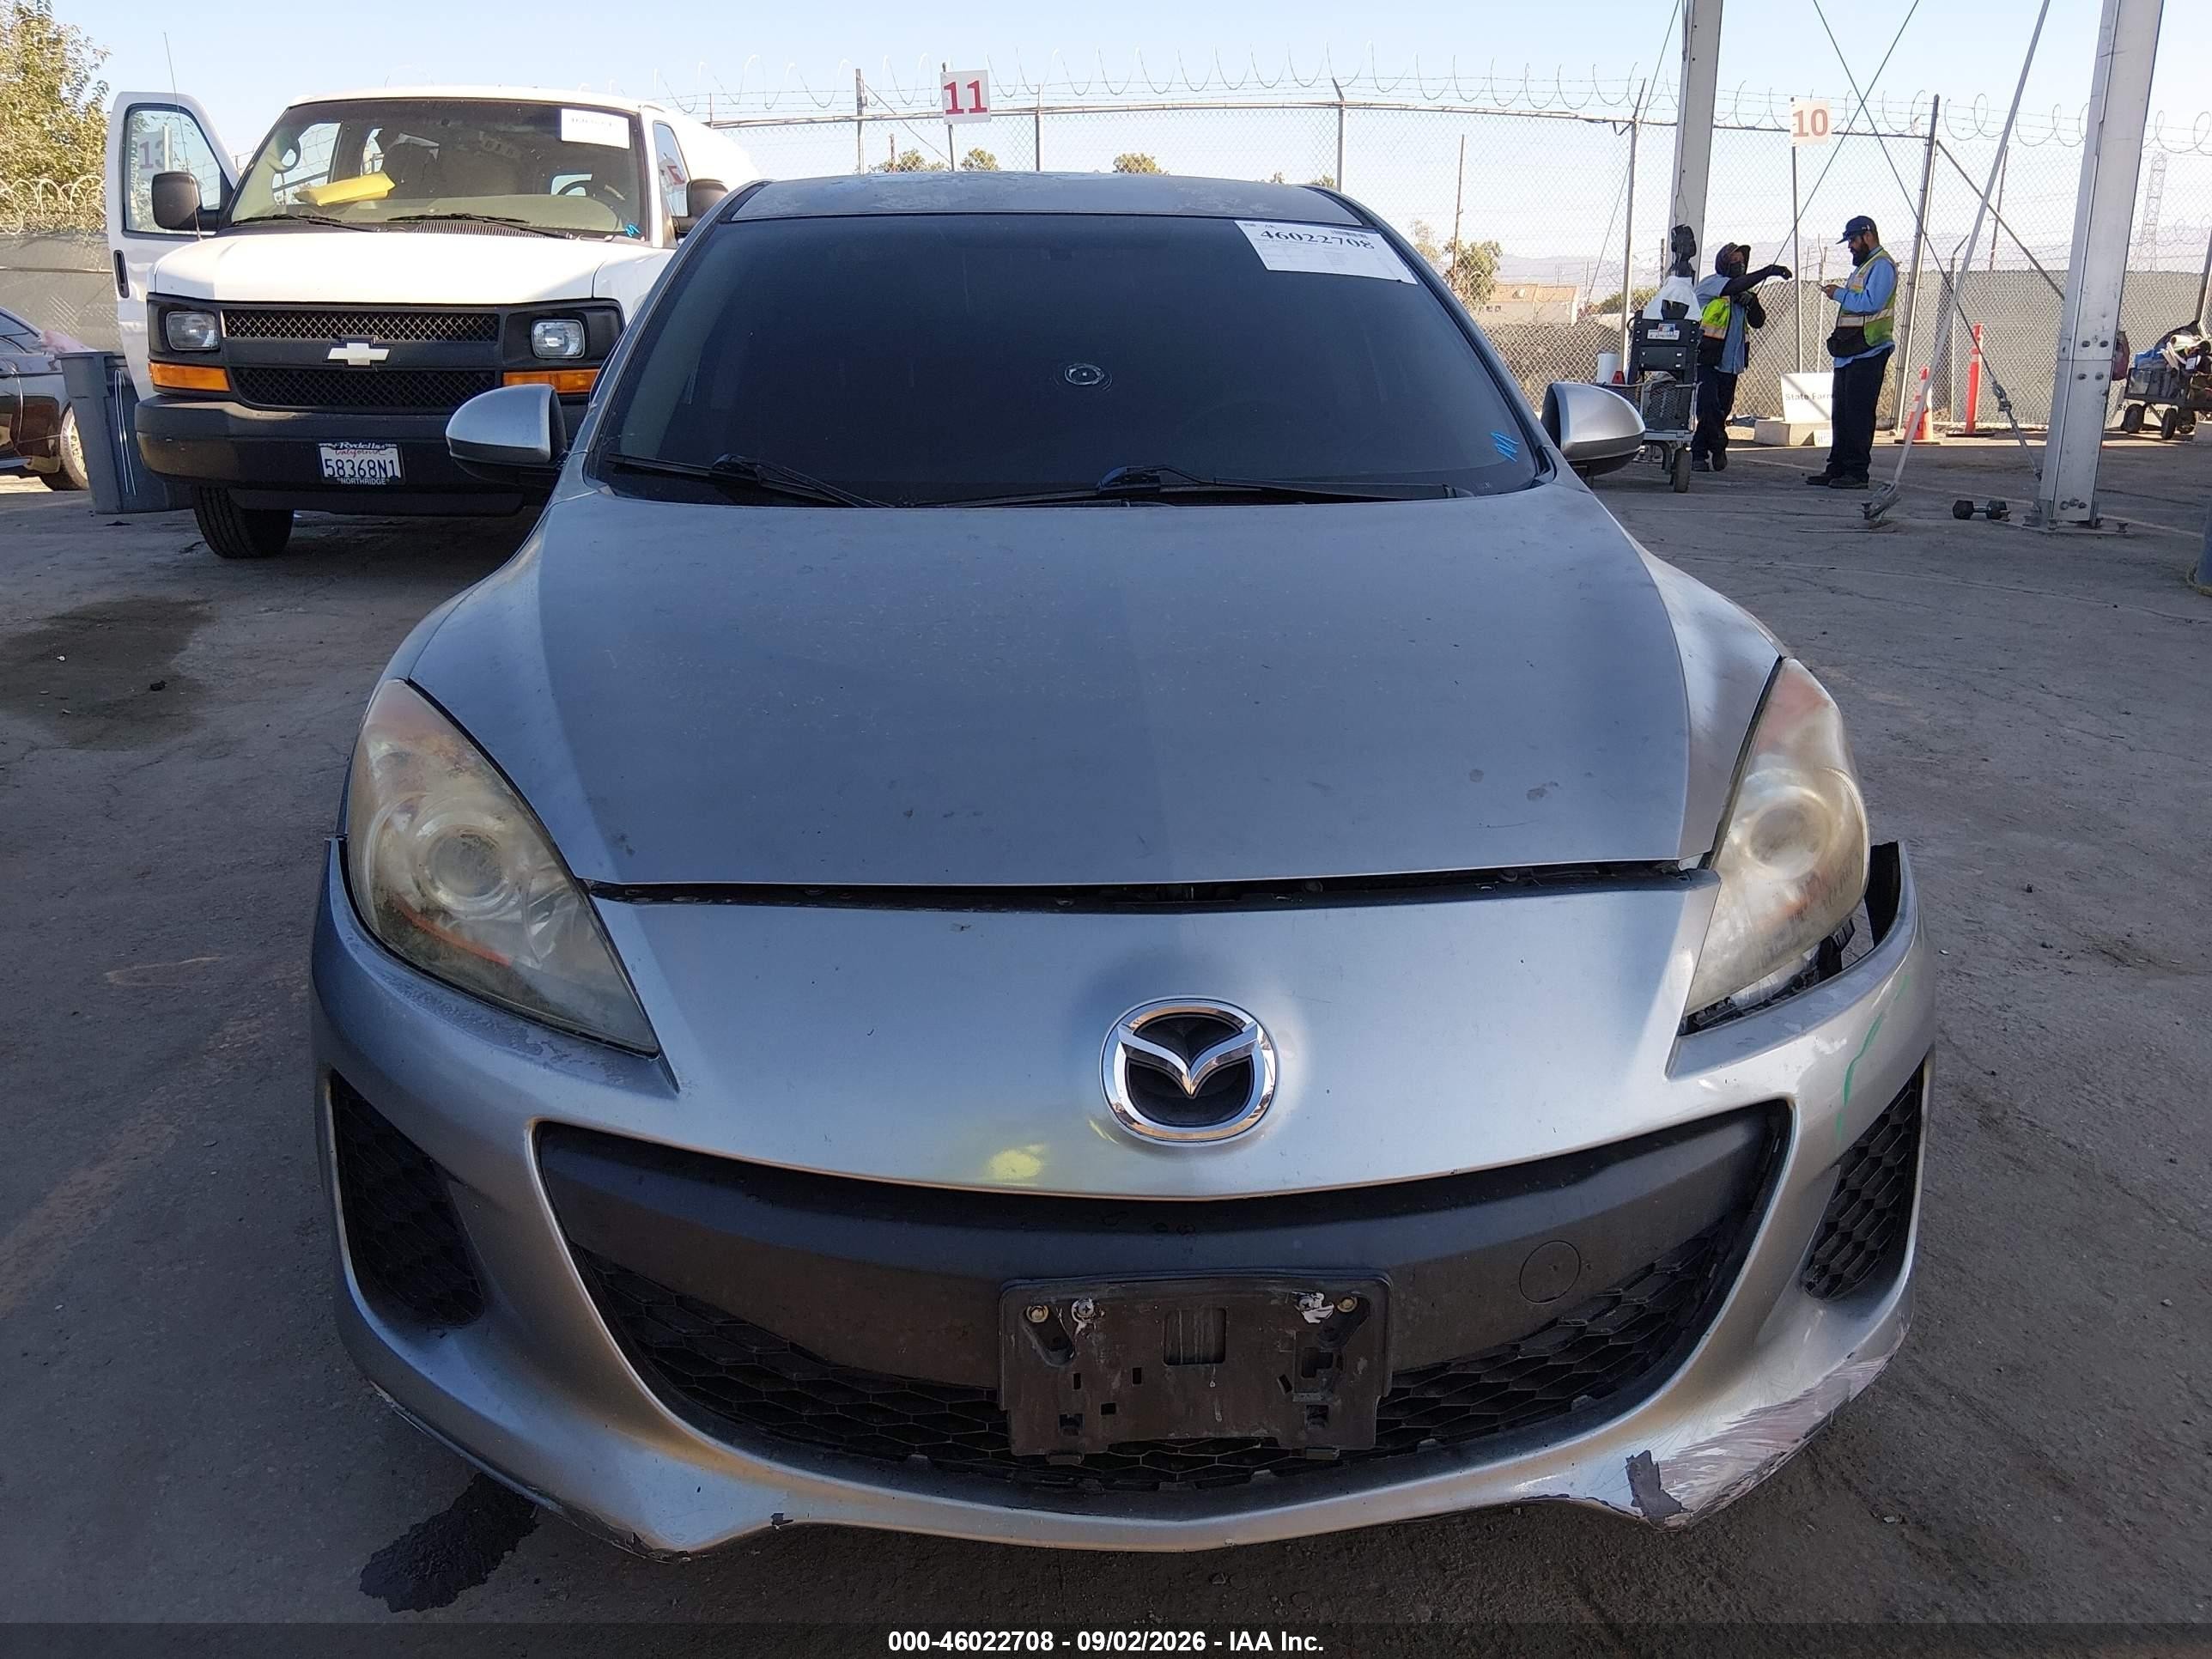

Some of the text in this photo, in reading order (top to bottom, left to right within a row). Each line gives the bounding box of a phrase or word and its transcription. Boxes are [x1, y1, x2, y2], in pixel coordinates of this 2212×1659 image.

[944, 80, 988, 114] 11
[1792, 108, 1828, 137] 10
[1260, 229, 1375, 250] 46022708
[1785, 392, 1809, 401] State
[324, 459, 398, 477] 58368N1
